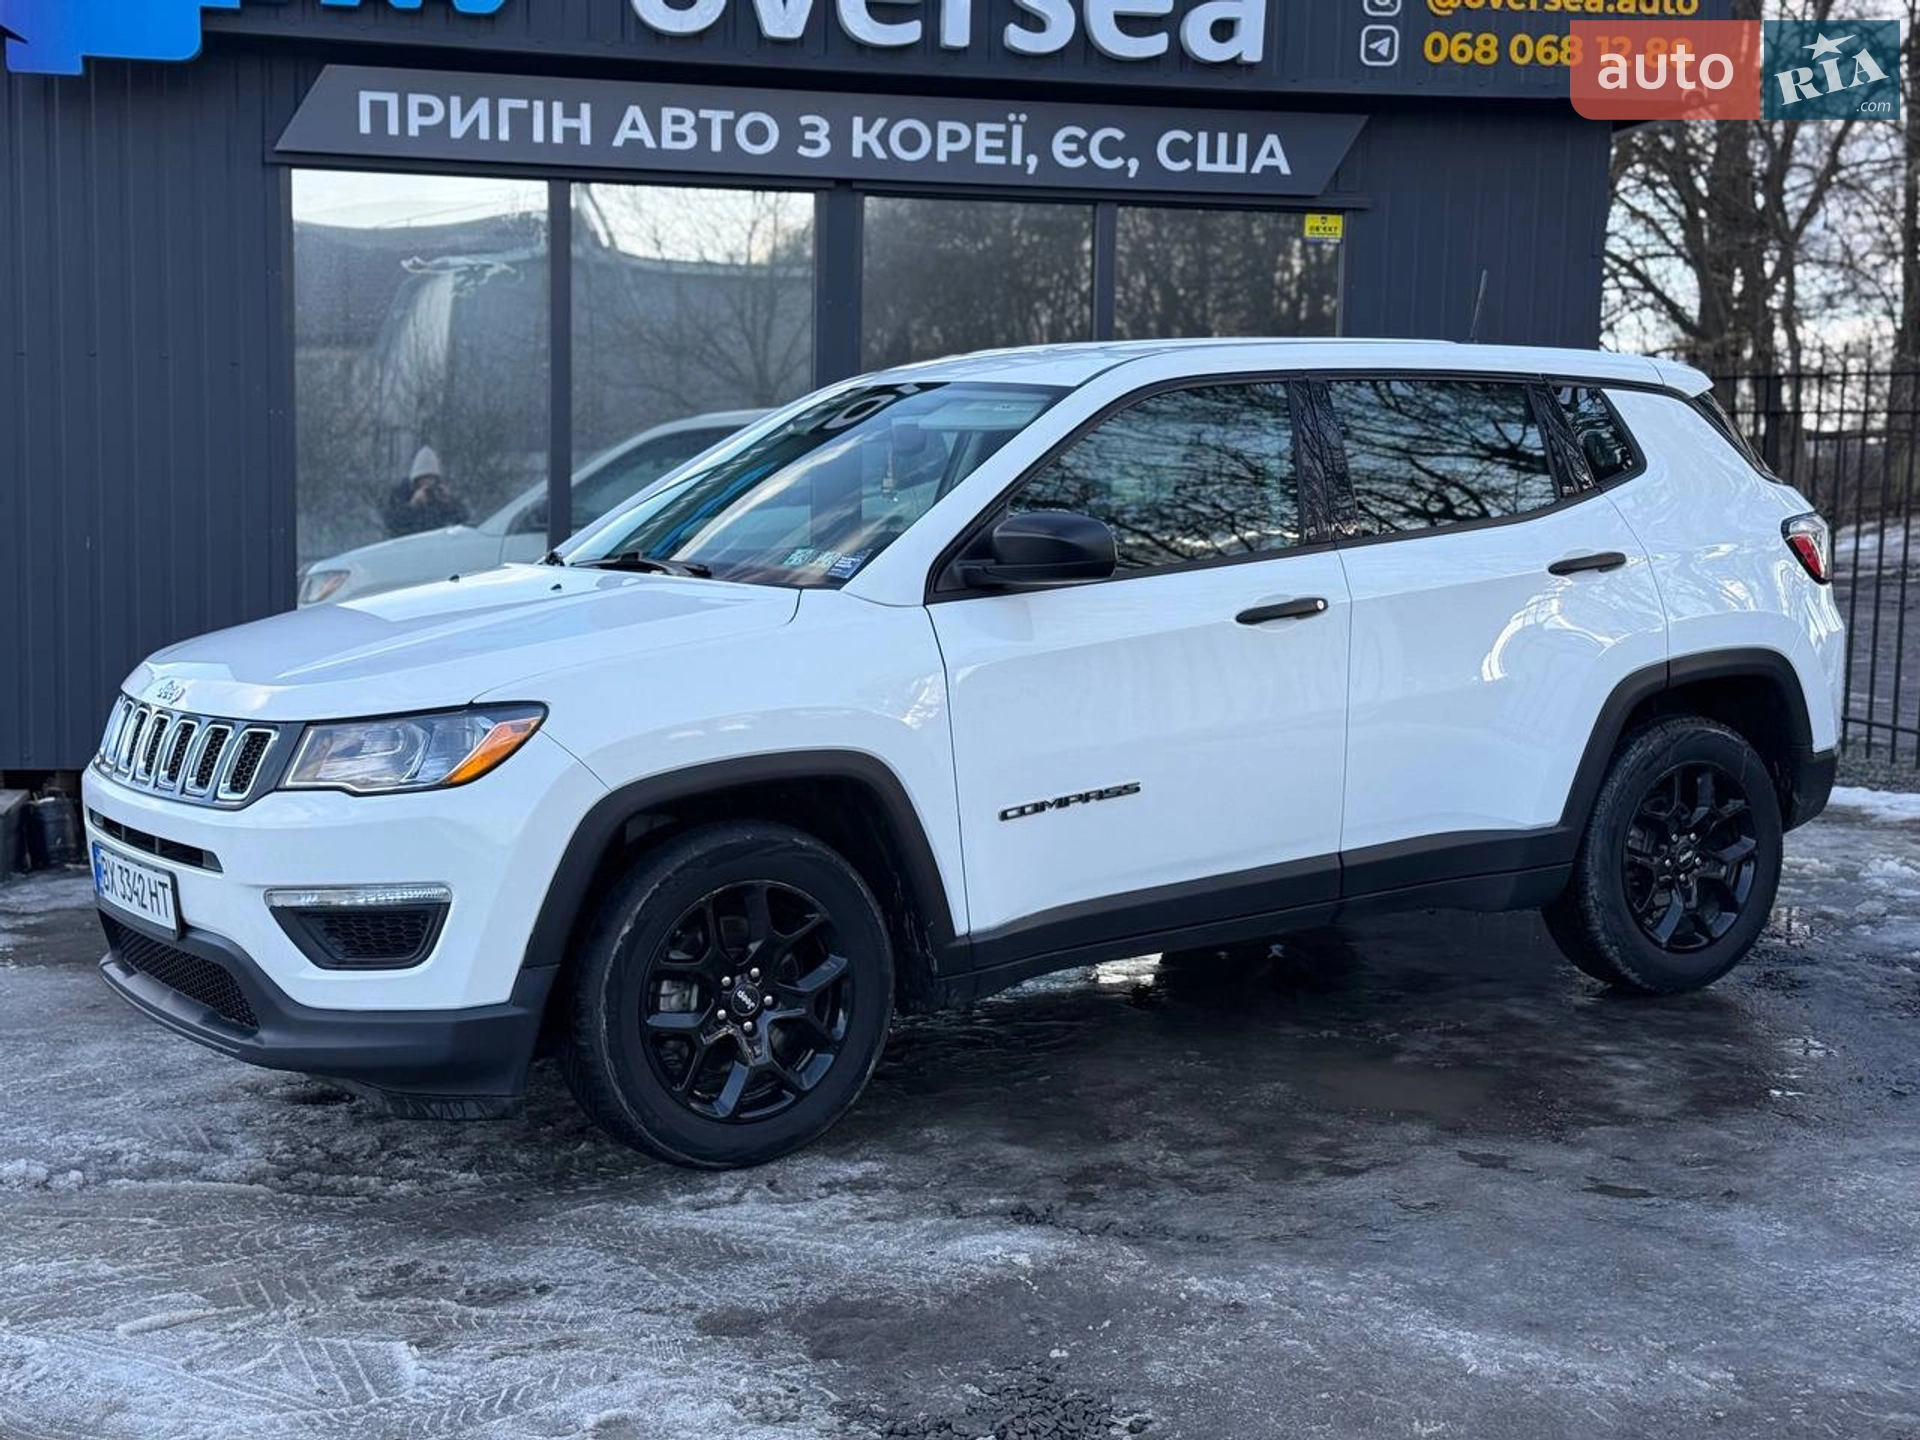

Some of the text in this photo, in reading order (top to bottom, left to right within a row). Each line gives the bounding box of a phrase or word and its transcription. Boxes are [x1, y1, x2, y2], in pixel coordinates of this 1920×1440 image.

[1424, 31, 1499, 64] 068
[1509, 33, 1584, 66] 068
[1596, 36, 1633, 68] 12
[358, 90, 1291, 178] ПРИГІН АВТО З КОРЕЇ, ЄС, США
[998, 781, 1142, 822] COMPASS
[118, 865, 147, 910] 3342
[148, 876, 169, 918] HT
